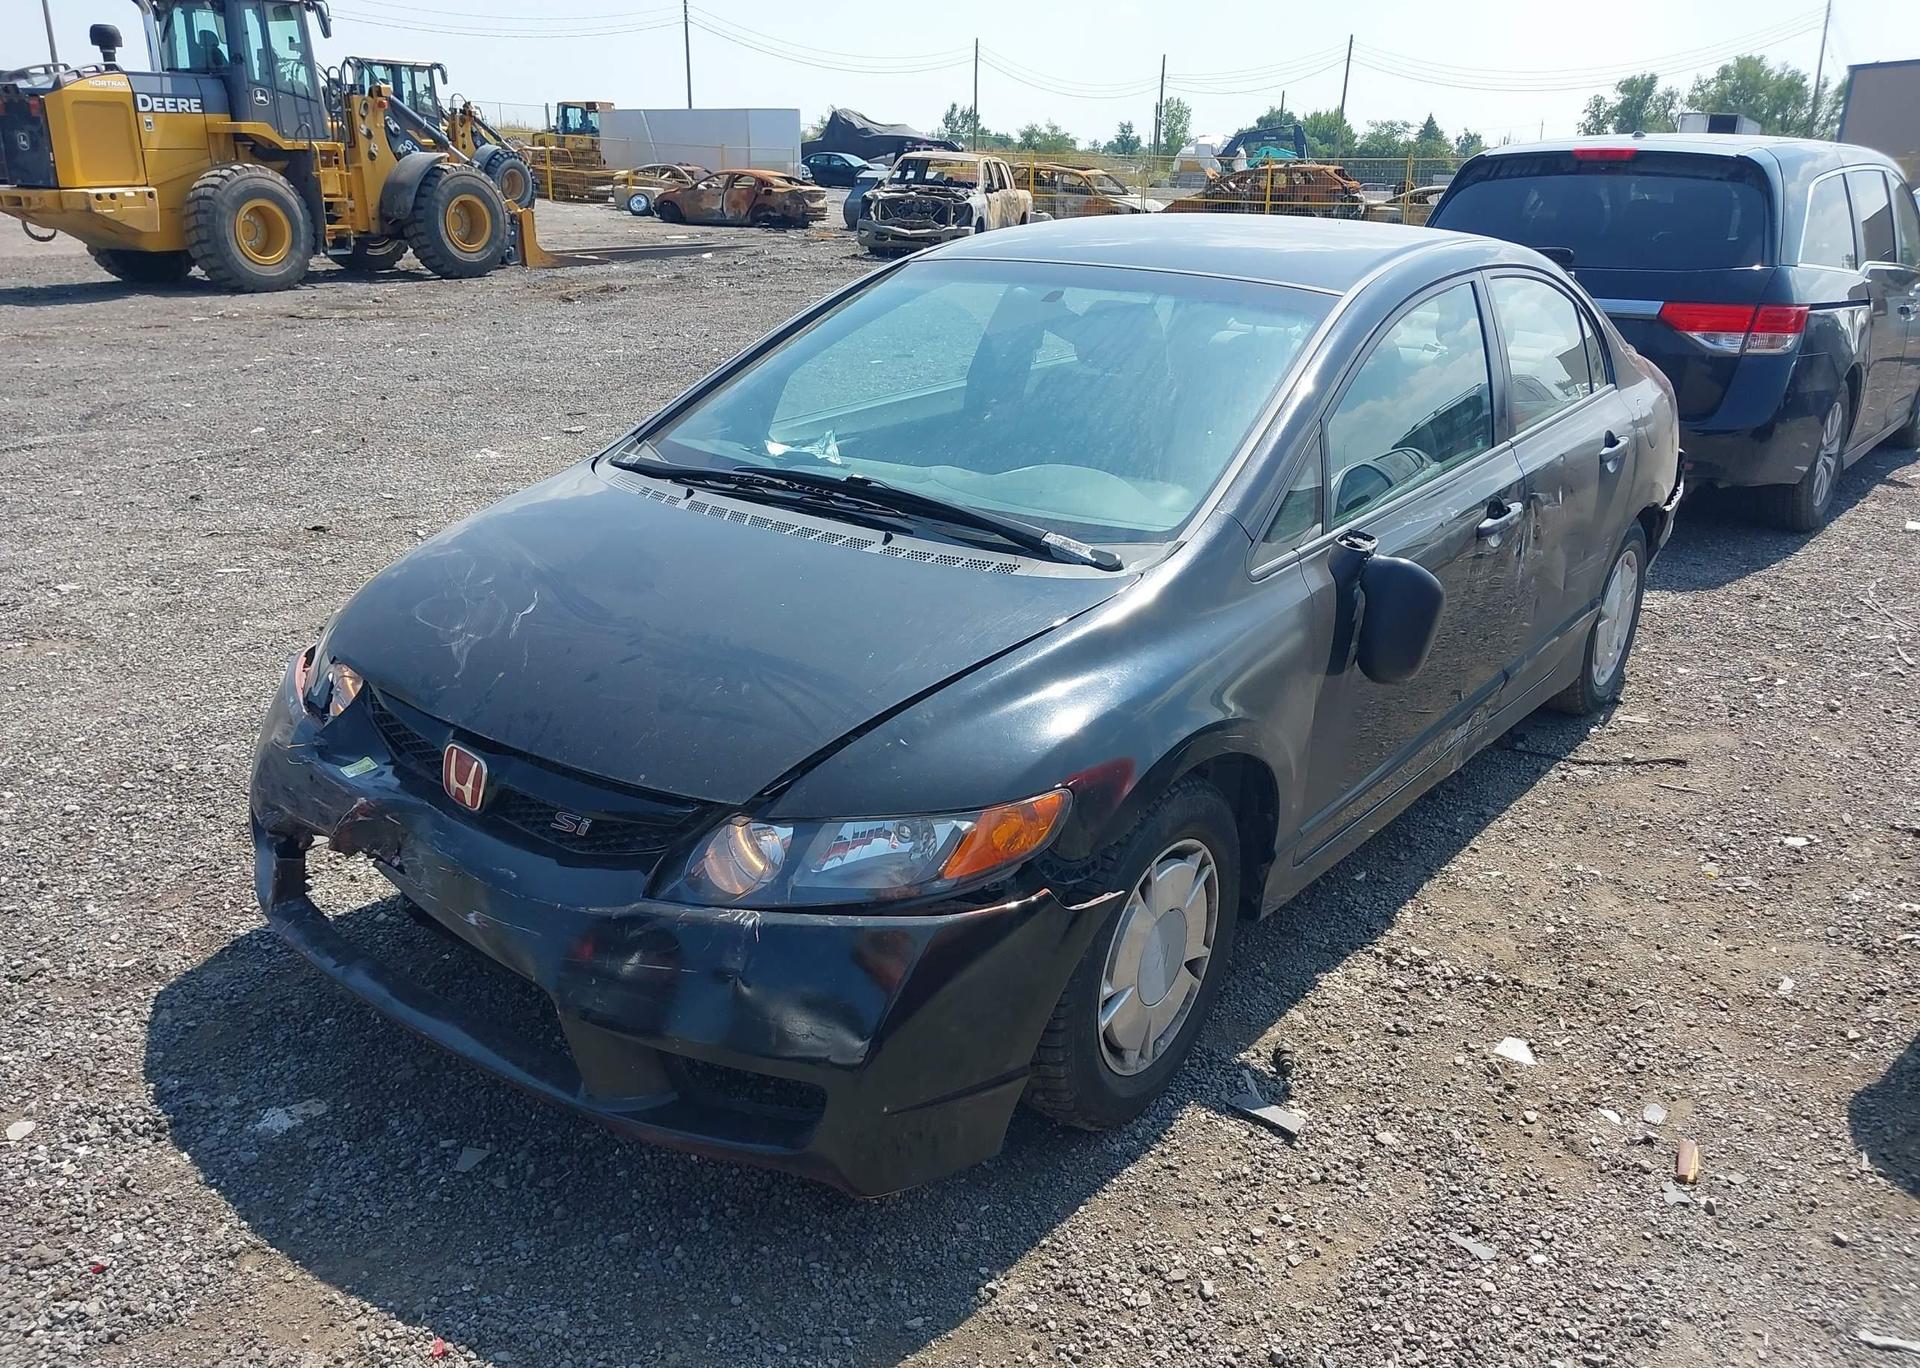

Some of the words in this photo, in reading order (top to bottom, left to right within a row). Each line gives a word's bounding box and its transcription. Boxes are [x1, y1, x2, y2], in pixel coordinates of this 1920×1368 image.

[88, 79, 127, 88] NORTRAX
[136, 93, 203, 113] DEERE
[550, 811, 593, 836] Si
